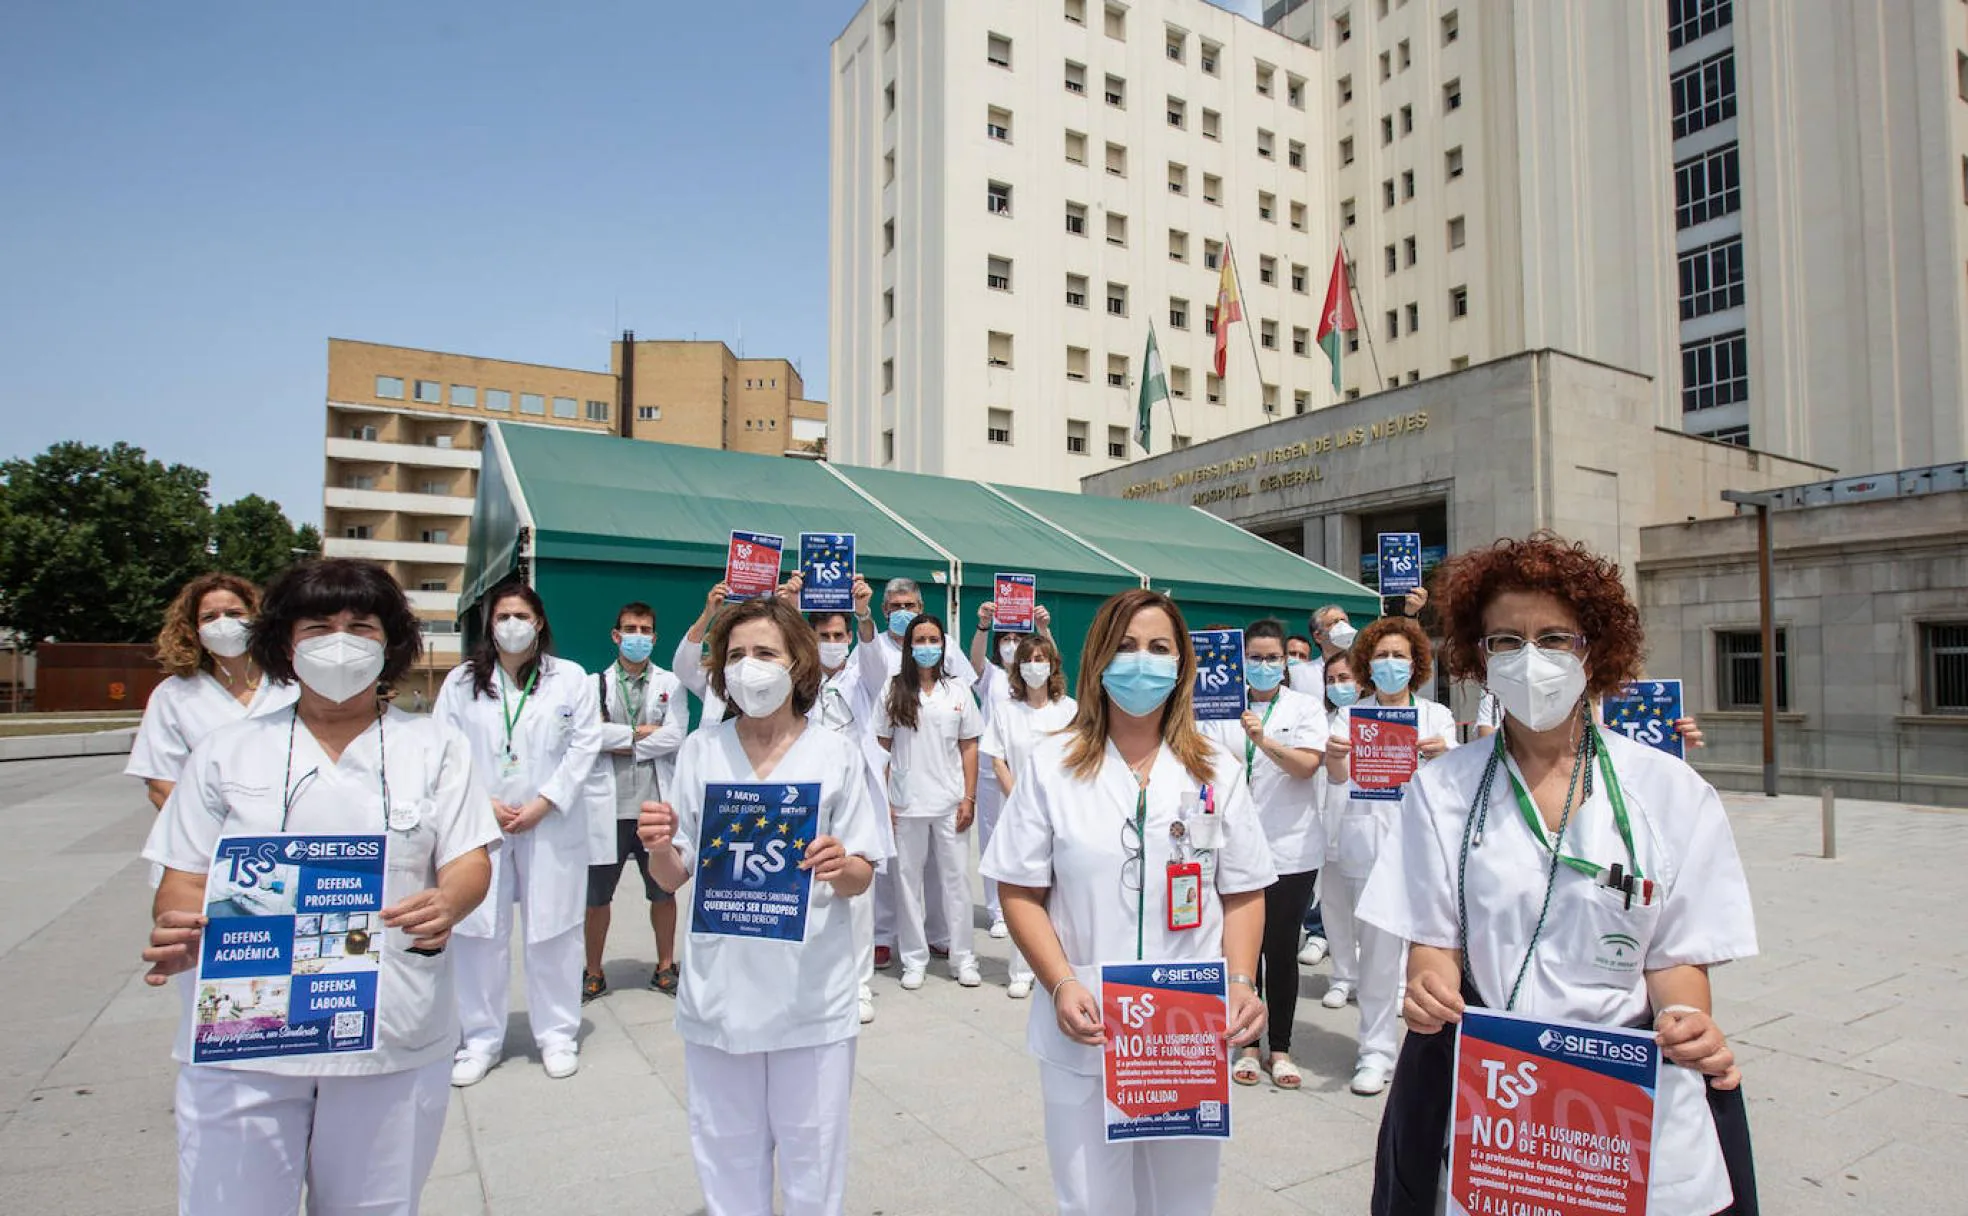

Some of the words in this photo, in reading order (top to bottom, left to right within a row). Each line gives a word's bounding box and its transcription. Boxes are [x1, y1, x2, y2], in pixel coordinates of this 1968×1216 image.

[1123, 479, 1168, 500] HOSPITAL
[1173, 456, 1257, 488] UNIVERSITARIO
[1262, 441, 1308, 466] VIRGEN
[1314, 436, 1331, 454] DE
[1336, 427, 1365, 448] LAS
[1371, 412, 1429, 440] NIEVES
[1193, 483, 1250, 506] HOSPITAL
[1260, 465, 1324, 491] GENERAL
[813, 561, 841, 586] TSS
[1390, 555, 1412, 576] TSS
[1197, 664, 1230, 694] TSS
[1358, 723, 1379, 742] TSS
[1356, 745, 1372, 758] NO
[725, 790, 732, 799] 9
[734, 791, 760, 802] MAYO
[719, 803, 731, 814] DÍA
[741, 805, 766, 814] EUROPA
[308, 841, 379, 857] SIETeSS
[226, 842, 278, 888] TSS
[728, 839, 786, 887] TSS
[317, 878, 362, 890] DEFENSA
[305, 893, 375, 906] PROFESIONAL
[704, 901, 744, 911] QUEREMOS
[747, 903, 759, 912] SER
[761, 904, 798, 916] EUROPEOS
[732, 913, 751, 922] PLENO
[752, 915, 778, 925] DERECHO
[223, 931, 271, 944] DEFENSA
[215, 945, 280, 962] ACADÉMICA
[1168, 968, 1220, 981] SIETeSS
[310, 979, 357, 992] DEFENSA
[310, 995, 357, 1010] LABORAL
[1117, 993, 1155, 1028] TSS
[1115, 1034, 1144, 1058] NO
[1145, 1034, 1152, 1044] A
[1153, 1034, 1163, 1044] LA
[1165, 1030, 1216, 1044] USURPACIÓN
[1146, 1047, 1158, 1057] DE
[1161, 1045, 1216, 1057] FUNCIONES
[1564, 1034, 1648, 1064] SIETeSS
[1481, 1059, 1538, 1110] TSS
[1117, 1089, 1125, 1105] SÍ
[1127, 1090, 1133, 1104] A
[1134, 1090, 1145, 1104] LA
[1146, 1090, 1178, 1103] CALIDAD
[1472, 1115, 1515, 1150] NO
[1519, 1120, 1528, 1136] A
[1532, 1122, 1547, 1139] LA
[1550, 1125, 1631, 1155] USURPACIÓN
[1485, 1153, 1534, 1169] profesionales
[1519, 1138, 1537, 1155] DE
[1543, 1143, 1630, 1173] FUNCIONES
[1468, 1189, 1481, 1211] SÍ
[1483, 1196, 1491, 1214] A
[1495, 1198, 1509, 1216] LA
